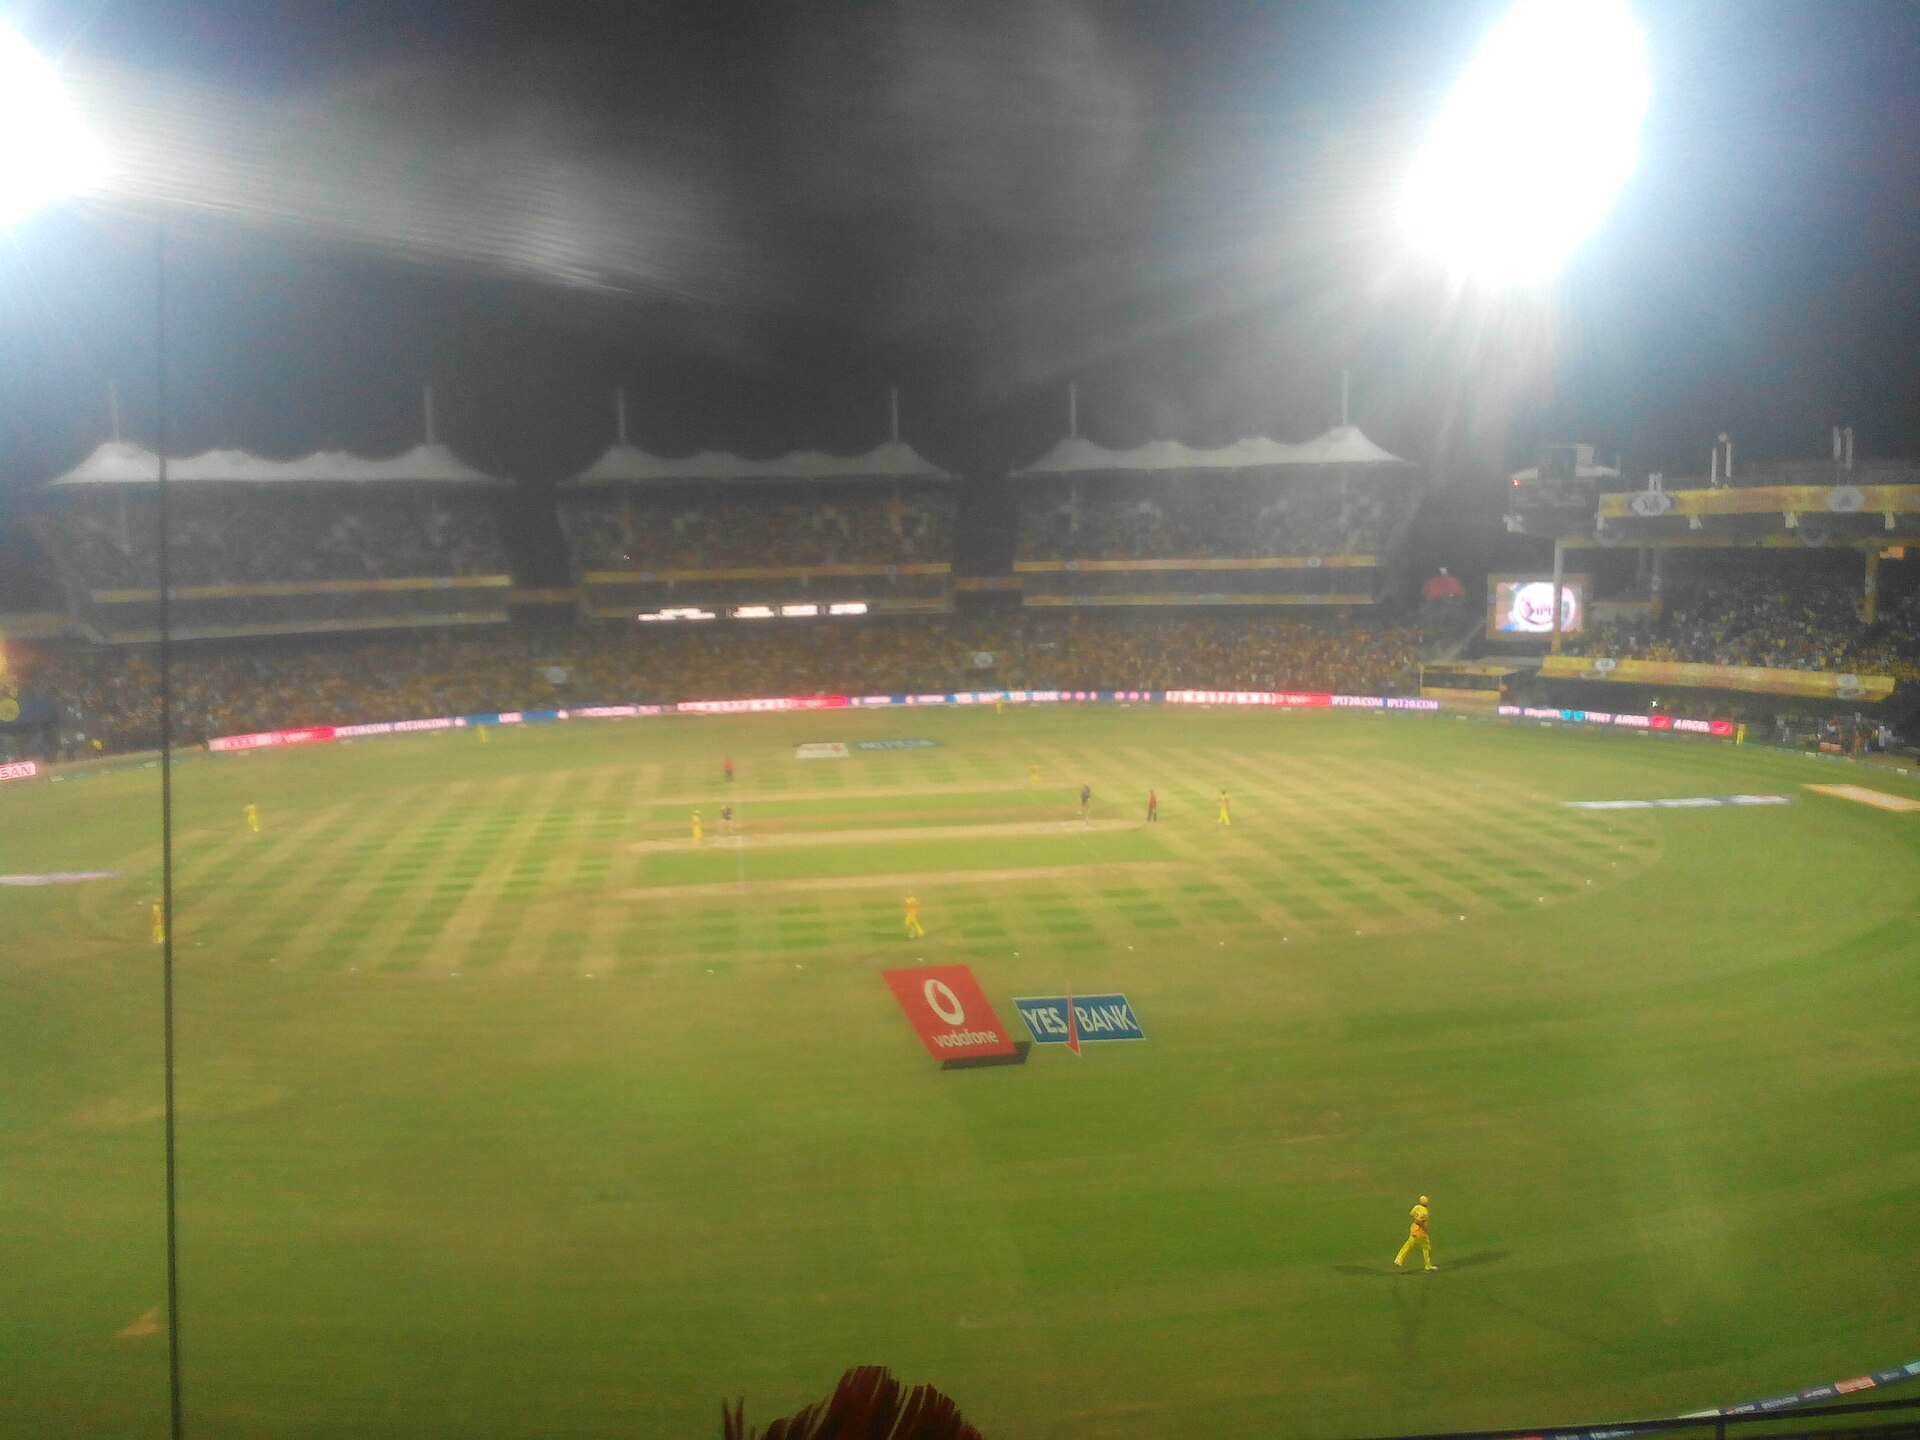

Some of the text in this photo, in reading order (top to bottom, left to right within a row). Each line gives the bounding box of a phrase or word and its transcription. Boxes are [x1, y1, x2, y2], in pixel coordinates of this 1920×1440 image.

[1021, 1004, 1139, 1035] YES BANK
[931, 1028, 999, 1048] vodafone
